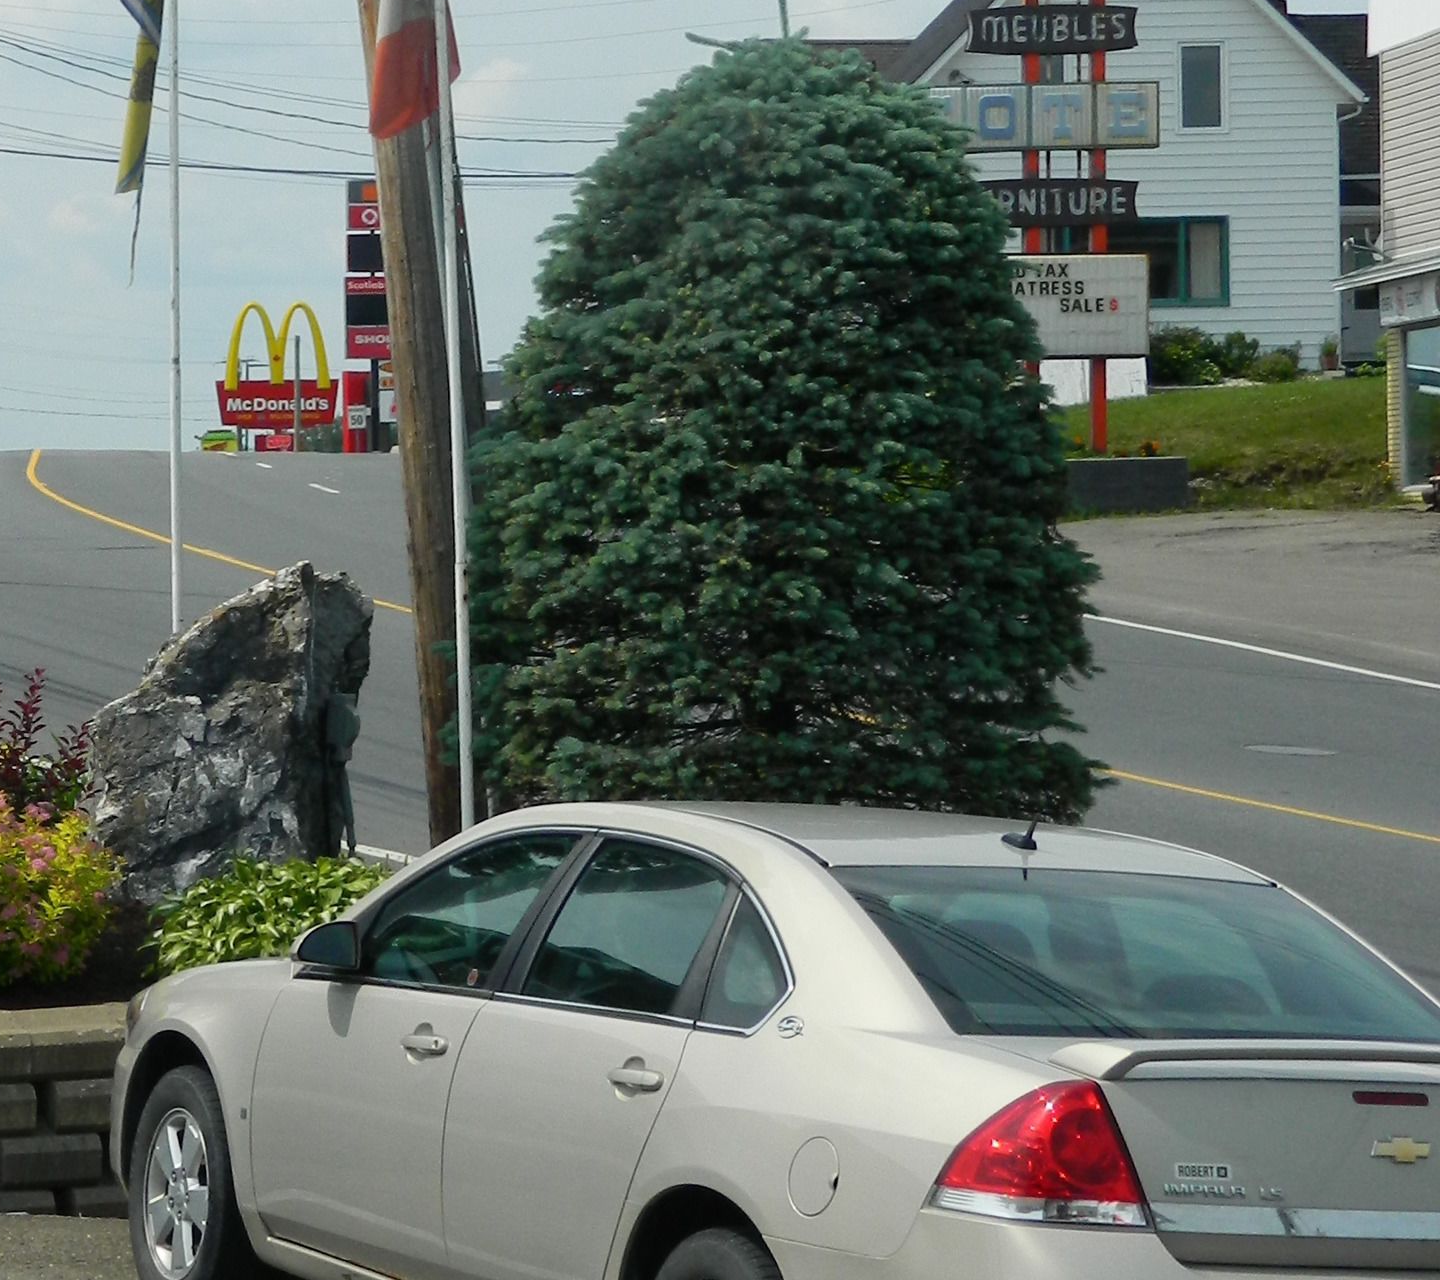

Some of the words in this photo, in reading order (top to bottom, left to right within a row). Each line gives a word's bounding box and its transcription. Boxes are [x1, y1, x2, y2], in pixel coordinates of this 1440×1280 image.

[981, 13, 1127, 43] MEUBLES
[928, 90, 1150, 140] OTE
[1009, 280, 1085, 296] ATRESS
[350, 414, 364, 426] 50
[1178, 1165, 1215, 1177] ROBERT
